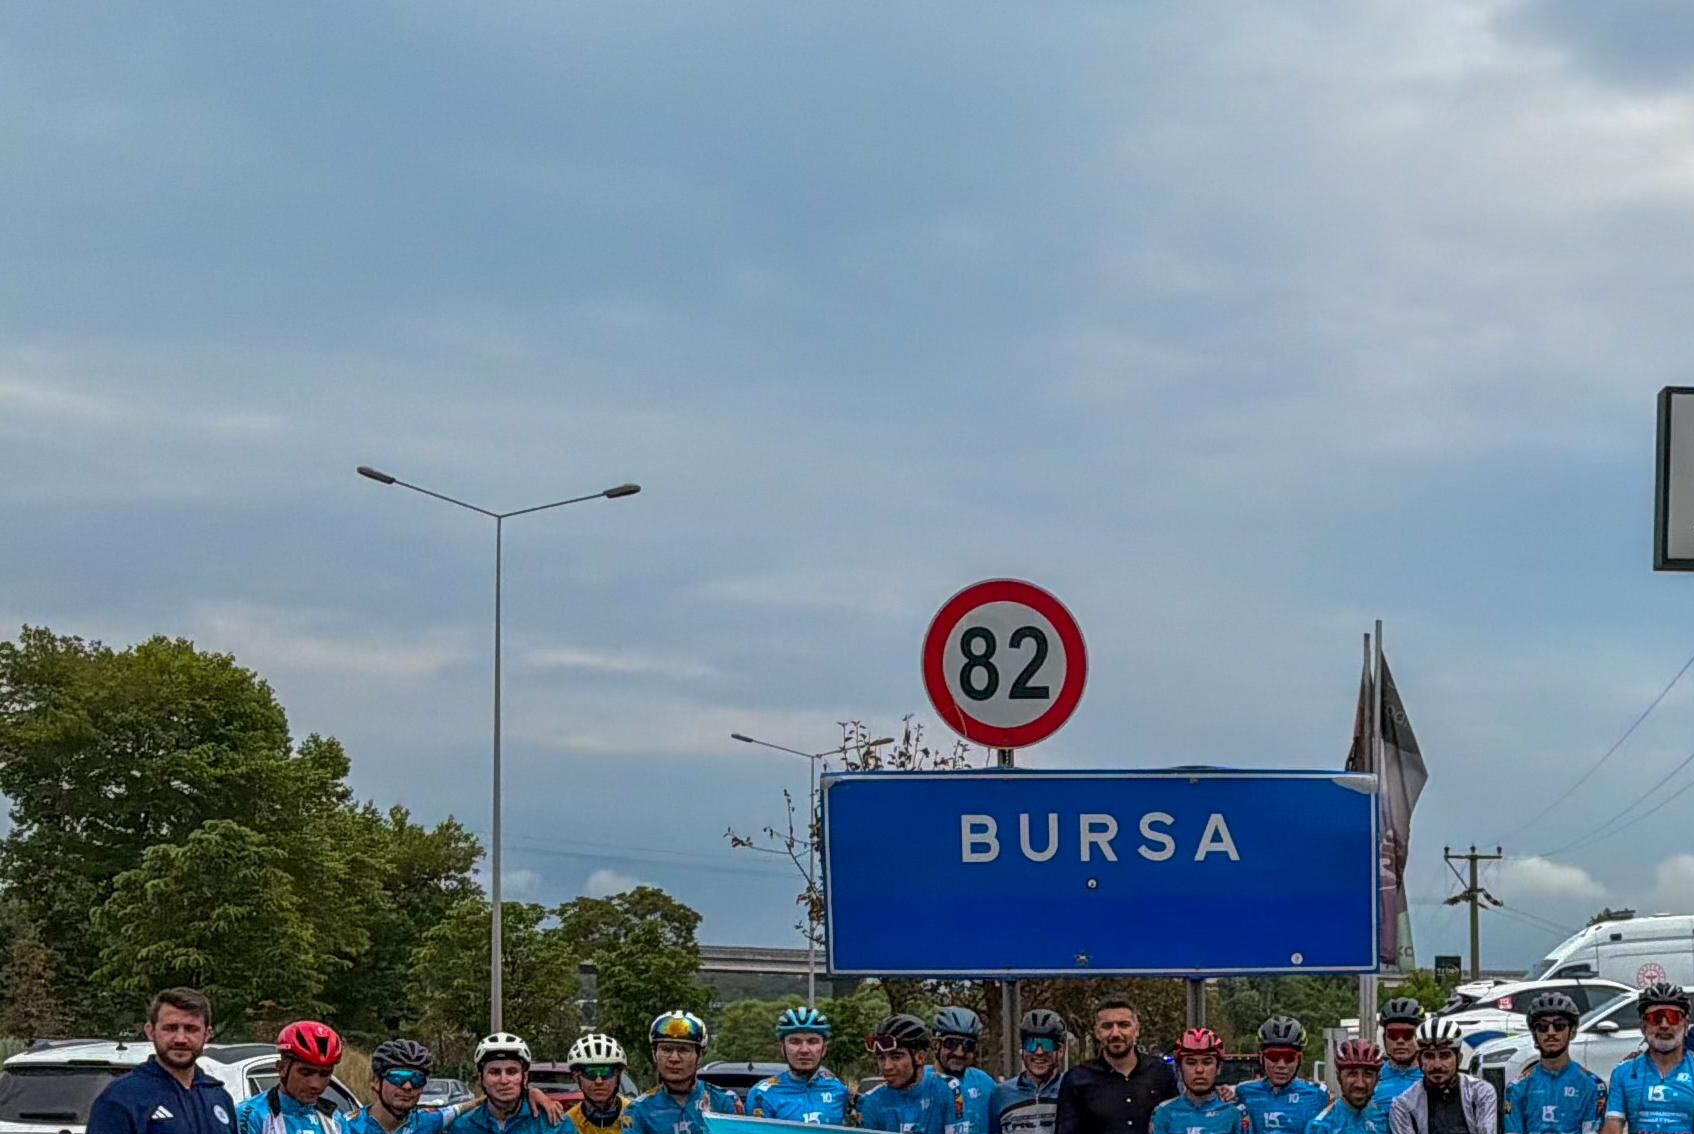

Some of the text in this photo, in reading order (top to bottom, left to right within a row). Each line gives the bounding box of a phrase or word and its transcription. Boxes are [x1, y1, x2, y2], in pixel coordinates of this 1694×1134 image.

[959, 625, 1050, 701] 82
[961, 811, 1240, 862] BURSA
[822, 1092, 833, 1103] 10
[1289, 1093, 1299, 1103] 10
[1648, 1086, 1668, 1102] 15
[1264, 1112, 1282, 1128] 15
